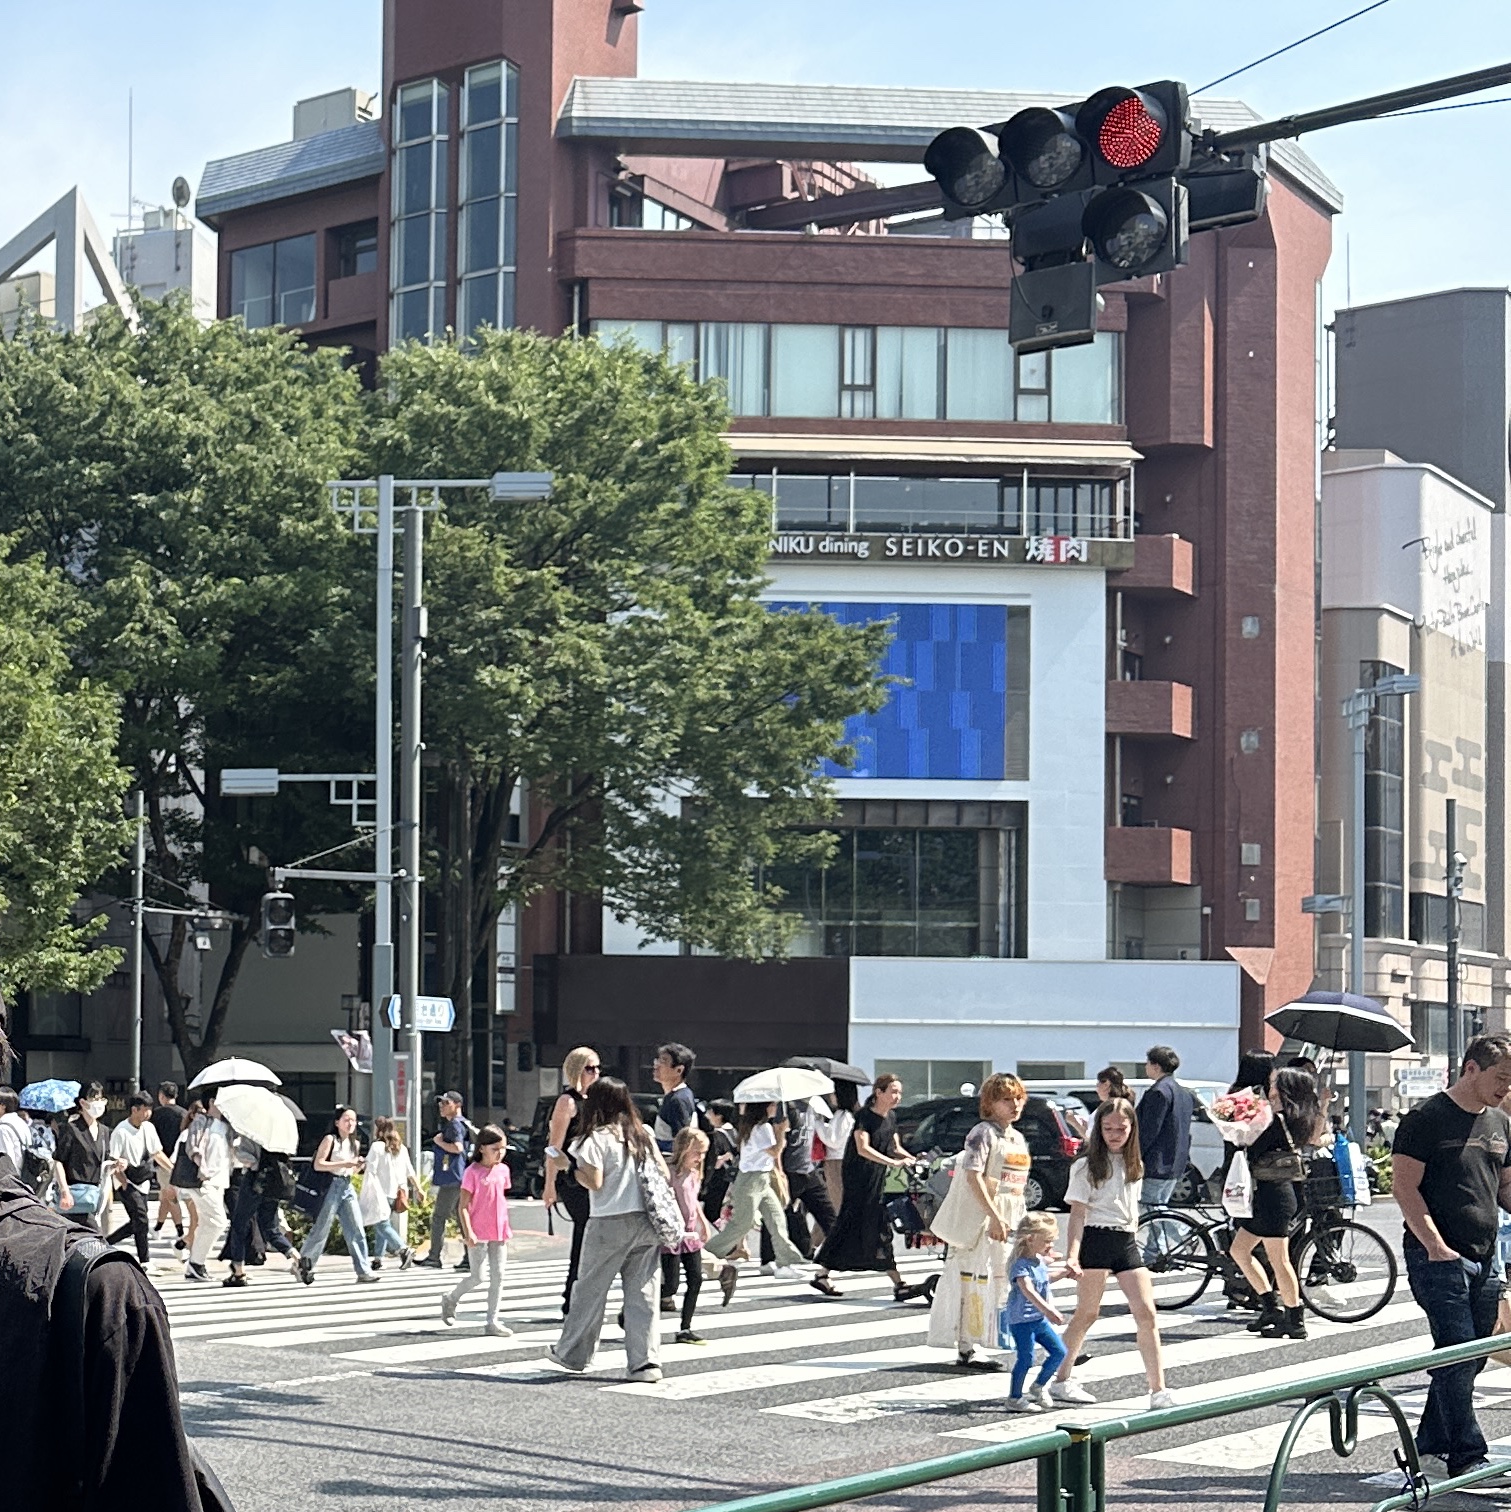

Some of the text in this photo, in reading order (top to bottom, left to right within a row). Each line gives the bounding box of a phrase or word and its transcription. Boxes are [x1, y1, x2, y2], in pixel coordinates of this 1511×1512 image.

[818, 536, 870, 559] dining
[884, 537, 1009, 558] SEIKO-EN
[1025, 535, 1088, 563] 焼肉
